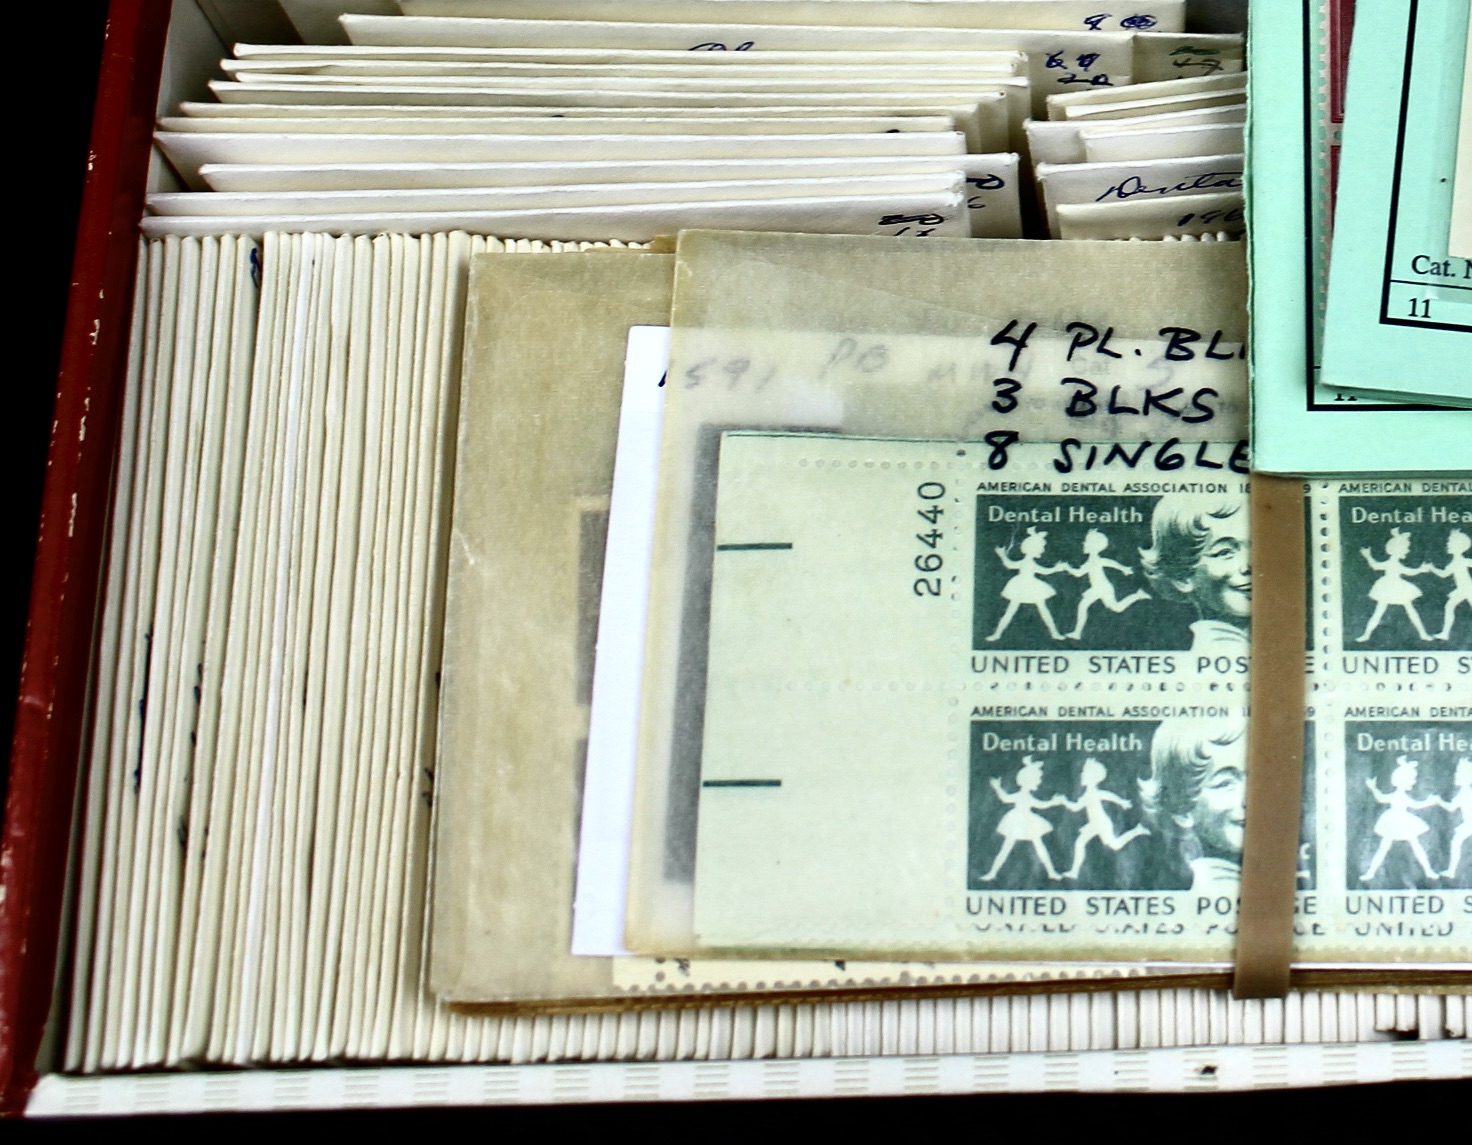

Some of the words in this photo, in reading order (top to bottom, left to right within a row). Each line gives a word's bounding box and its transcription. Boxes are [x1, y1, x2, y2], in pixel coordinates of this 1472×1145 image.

[1411, 255, 1456, 278] Cat.
[990, 319, 1038, 371] 4
[1065, 322, 1142, 360] PL.
[1158, 327, 1248, 361] BL
[991, 378, 1022, 414] 3
[1060, 377, 1219, 424] BLKS
[985, 431, 1019, 470] 8
[977, 482, 1051, 493] AMERICAN
[1061, 482, 1116, 493] DENTAL
[1123, 483, 1227, 493] ASSOCIATION
[1339, 481, 1412, 493] AMERICAN
[988, 506, 1060, 523] Dental
[1068, 505, 1143, 523] Health
[1351, 507, 1423, 524] Dental
[914, 481, 946, 596] 26440
[971, 656, 1070, 674] UNITED
[1089, 656, 1176, 674] STATES
[1342, 656, 1439, 675] UNITED
[1357, 732, 1431, 752] Dental
[1345, 895, 1444, 914] UNITED
